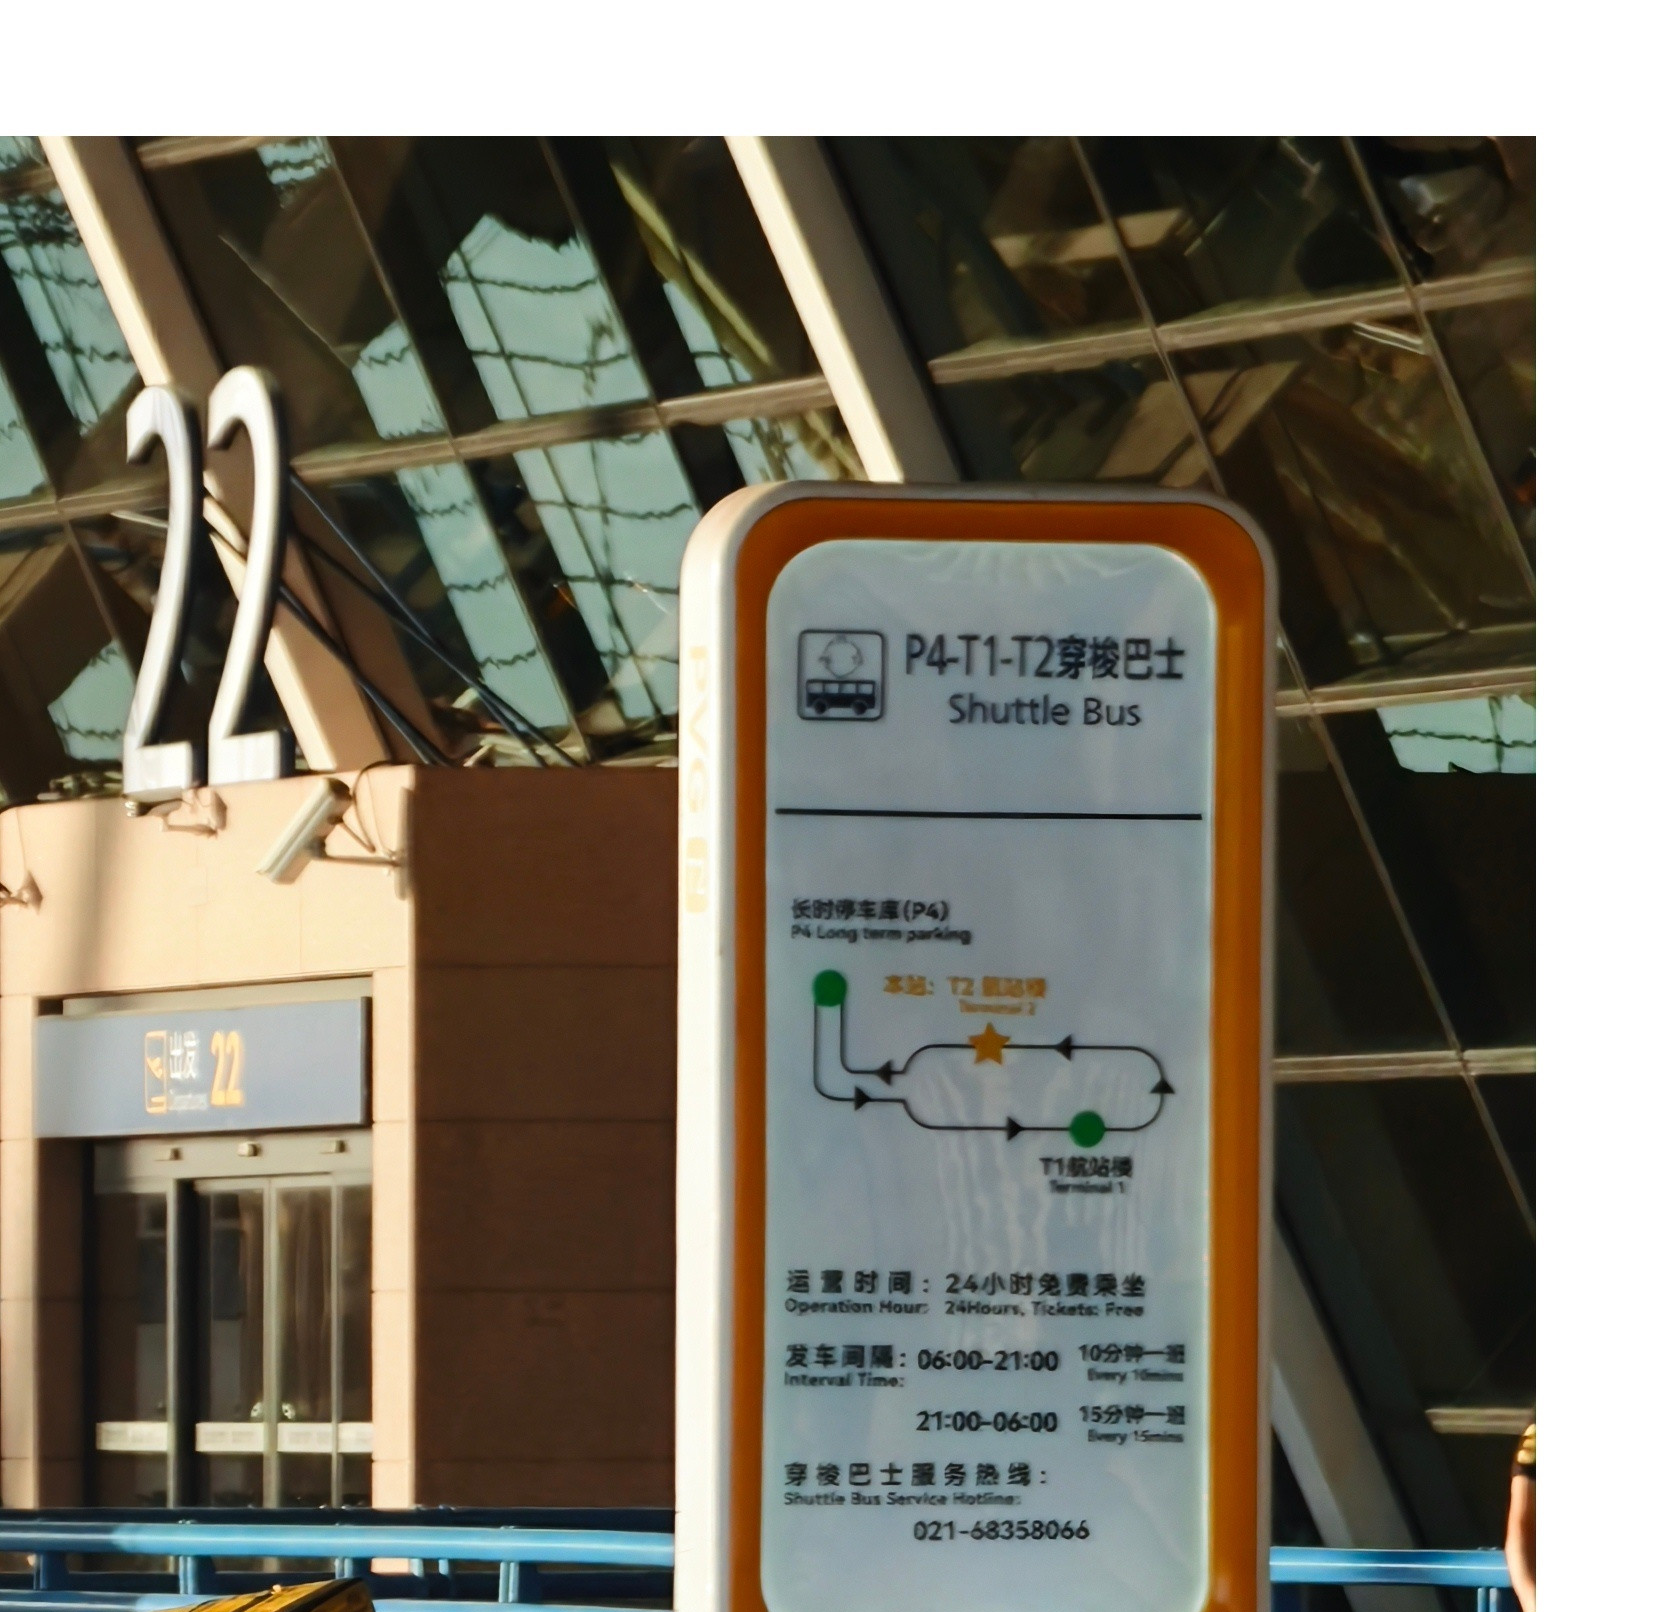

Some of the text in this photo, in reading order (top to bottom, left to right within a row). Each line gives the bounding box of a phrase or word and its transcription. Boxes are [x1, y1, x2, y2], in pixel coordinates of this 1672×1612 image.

[125, 366, 290, 796] 22
[905, 634, 1185, 680] P4-T1-T2穿梭巴士
[949, 693, 1142, 726] Shuttle Bus
[687, 645, 708, 814] PVG
[791, 925, 811, 939] P4
[817, 926, 858, 943] Long
[906, 926, 972, 945] parking
[947, 976, 974, 996] T2
[210, 1030, 244, 1107] 22
[1039, 1156, 1133, 1178] T1航站楼
[945, 1272, 1145, 1297] 24小时免费乘坐
[784, 1298, 873, 1316] Operation
[1105, 1302, 1144, 1317] Free
[917, 1349, 1059, 1371] 06:00-21:00
[784, 1371, 853, 1387] Interval
[857, 1371, 905, 1387] Time:
[916, 1411, 1058, 1432] 21:00-06:00
[784, 1492, 846, 1506] Shuttle
[851, 1492, 881, 1506] Bus
[886, 1492, 946, 1506] Service
[913, 1519, 1090, 1541] 021-68358066
